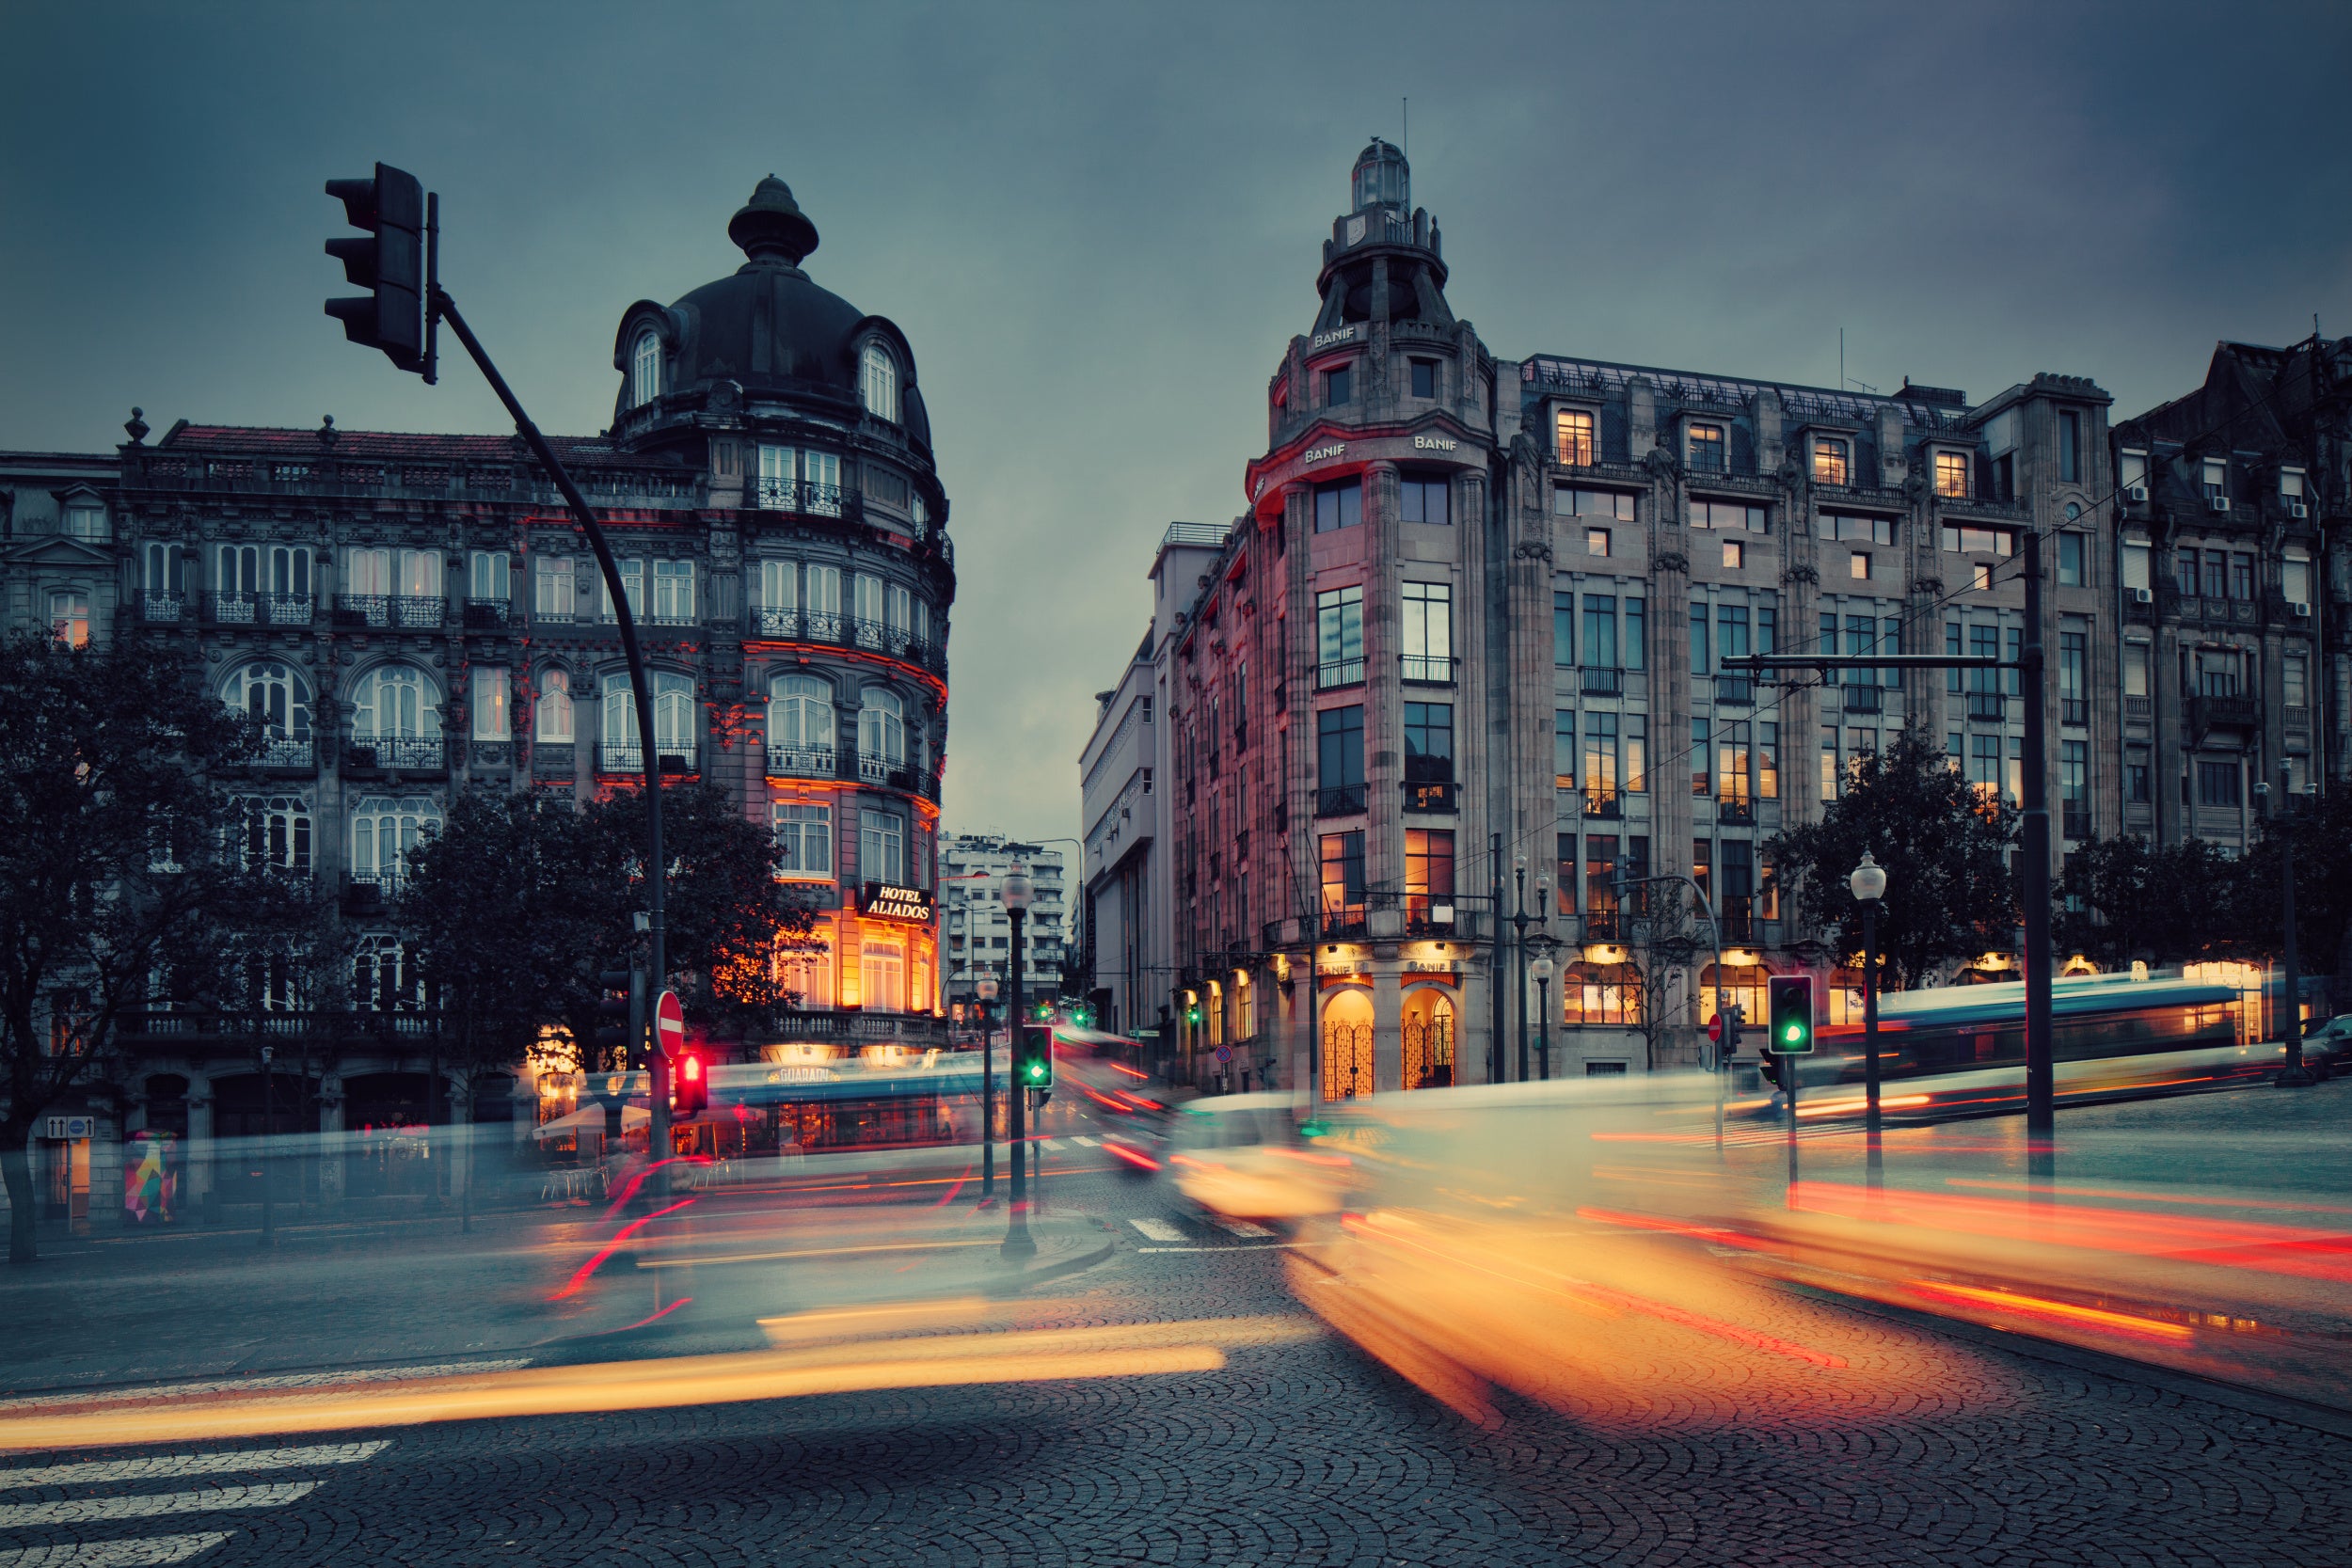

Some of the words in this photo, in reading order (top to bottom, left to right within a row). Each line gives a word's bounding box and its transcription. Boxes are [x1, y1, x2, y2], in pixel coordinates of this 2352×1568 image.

[1314, 326, 1354, 348] BANIF
[1414, 436, 1457, 451] BANIF
[1305, 444, 1345, 464] BANIF
[880, 886, 921, 903] HOTEL
[867, 900, 930, 919] ALIADOS
[1316, 964, 1350, 975] BANIF
[1408, 961, 1445, 973] BANIF
[780, 1068, 829, 1082] GUARANY
